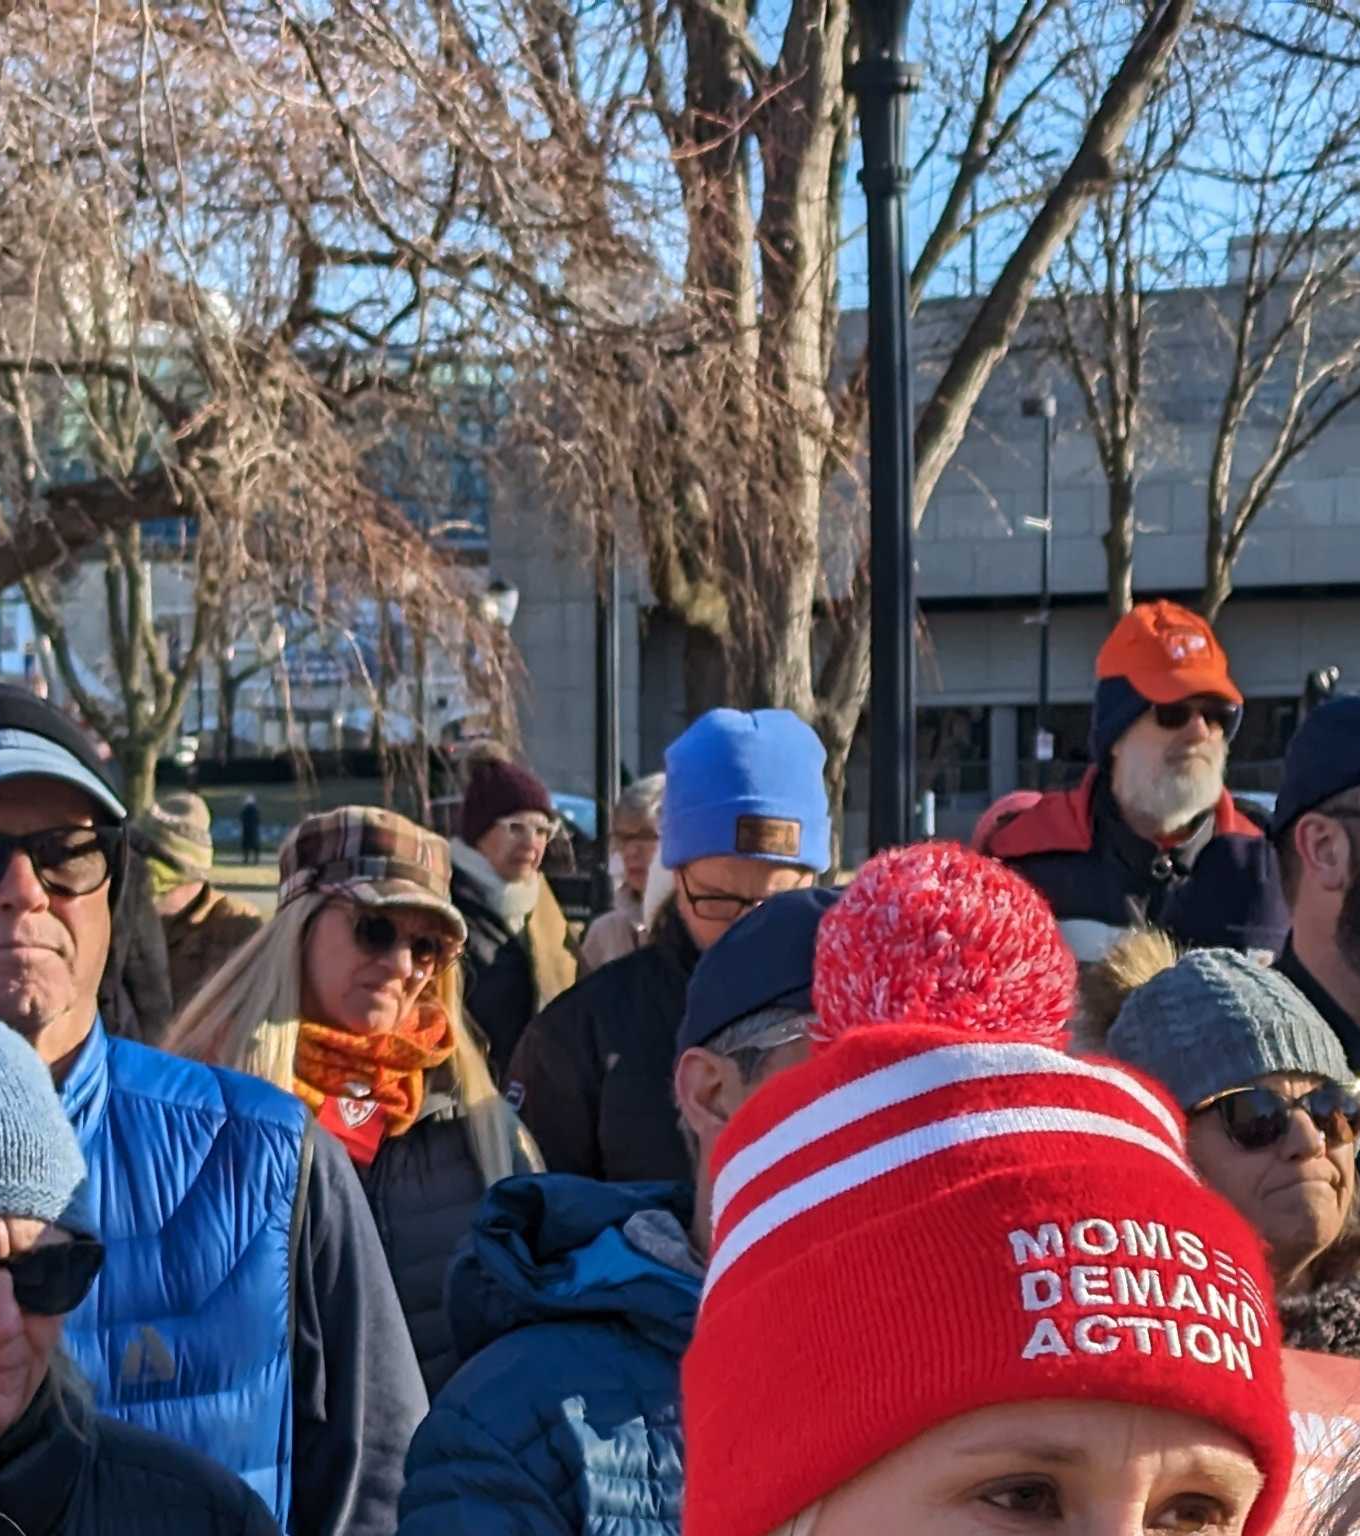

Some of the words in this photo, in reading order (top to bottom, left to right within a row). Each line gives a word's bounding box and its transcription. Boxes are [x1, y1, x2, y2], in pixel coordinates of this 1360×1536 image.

[1008, 1218, 1208, 1271] MOMS
[1020, 1265, 1262, 1348] DEMAND
[1021, 1314, 1253, 1381] ACTION
